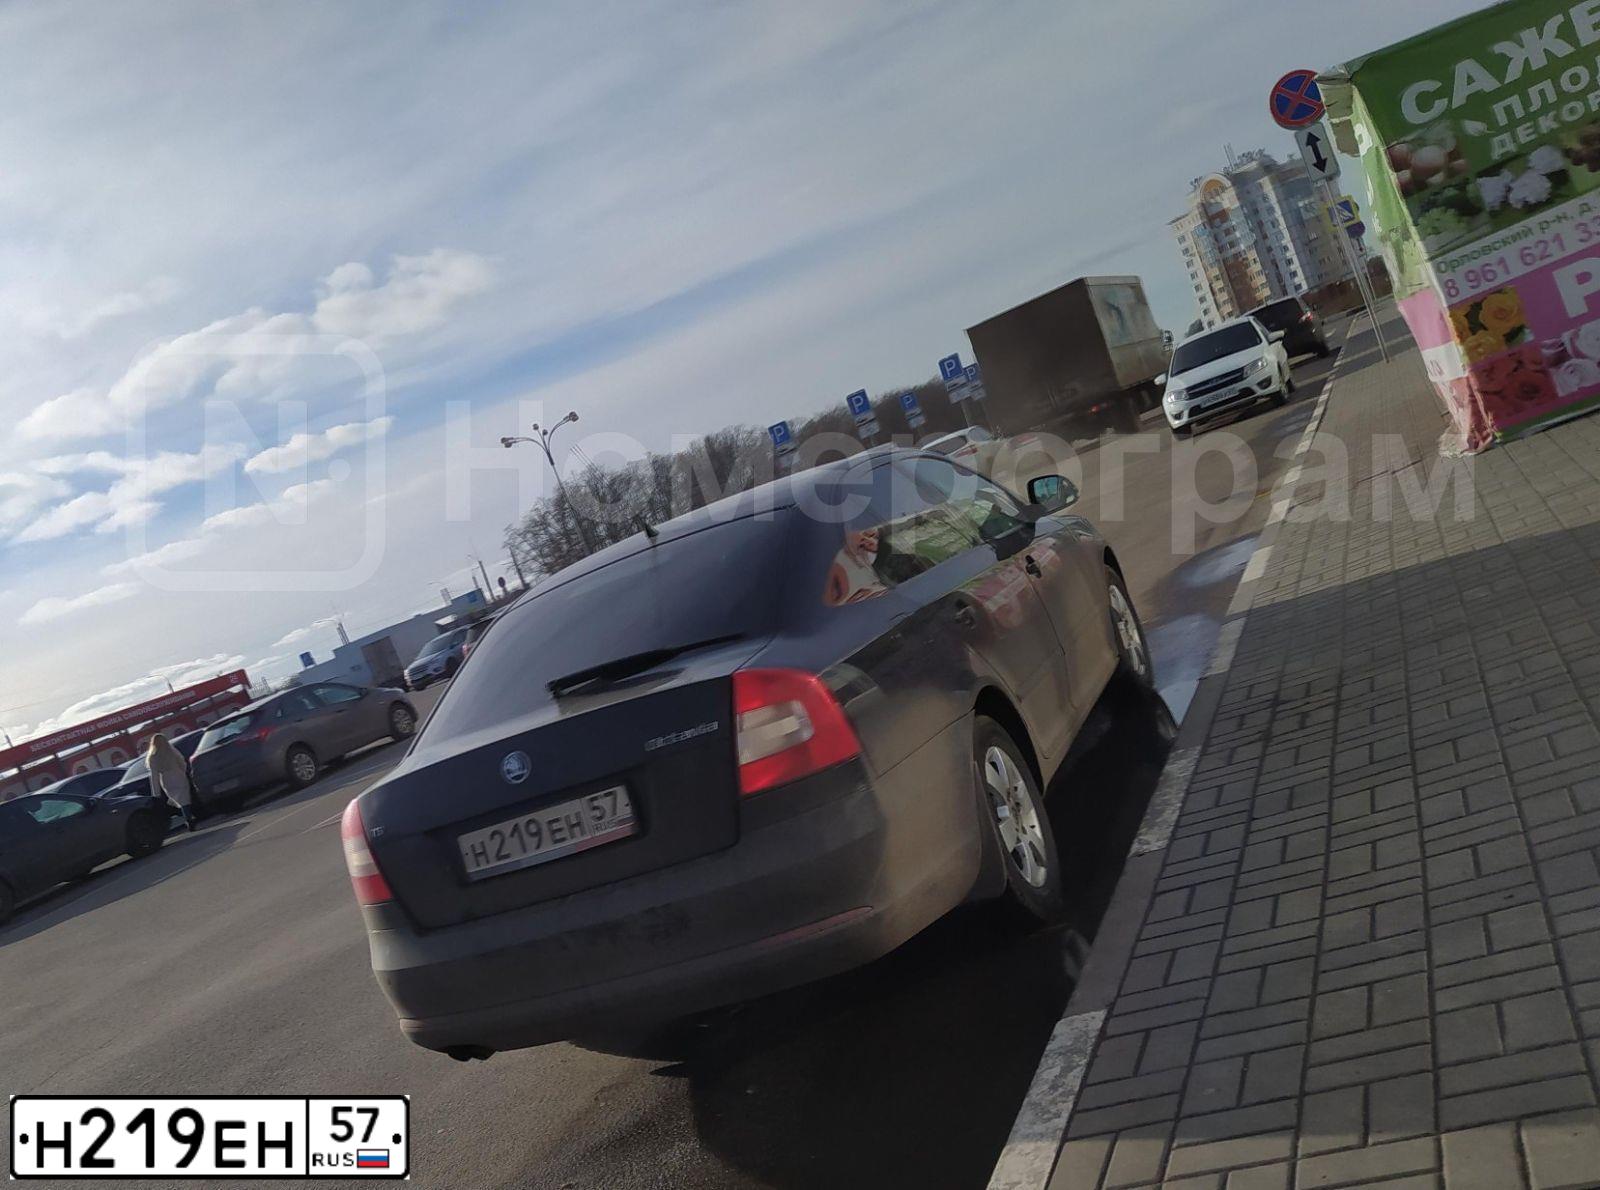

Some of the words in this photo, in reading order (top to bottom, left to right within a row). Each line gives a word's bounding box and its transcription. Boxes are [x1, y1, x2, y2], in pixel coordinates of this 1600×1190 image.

[1401, 0, 1600, 125] САЖЕ
[1493, 55, 1600, 127] ПЛО
[1436, 225, 1534, 273] Орловский
[1444, 278, 1459, 298] 8
[1464, 256, 1510, 290] 961
[1519, 232, 1566, 266] 621
[944, 359, 956, 378] P
[851, 395, 864, 413] P
[772, 425, 785, 443] P
[470, 811, 587, 867] Н219ЕН
[587, 790, 617, 822] 57
